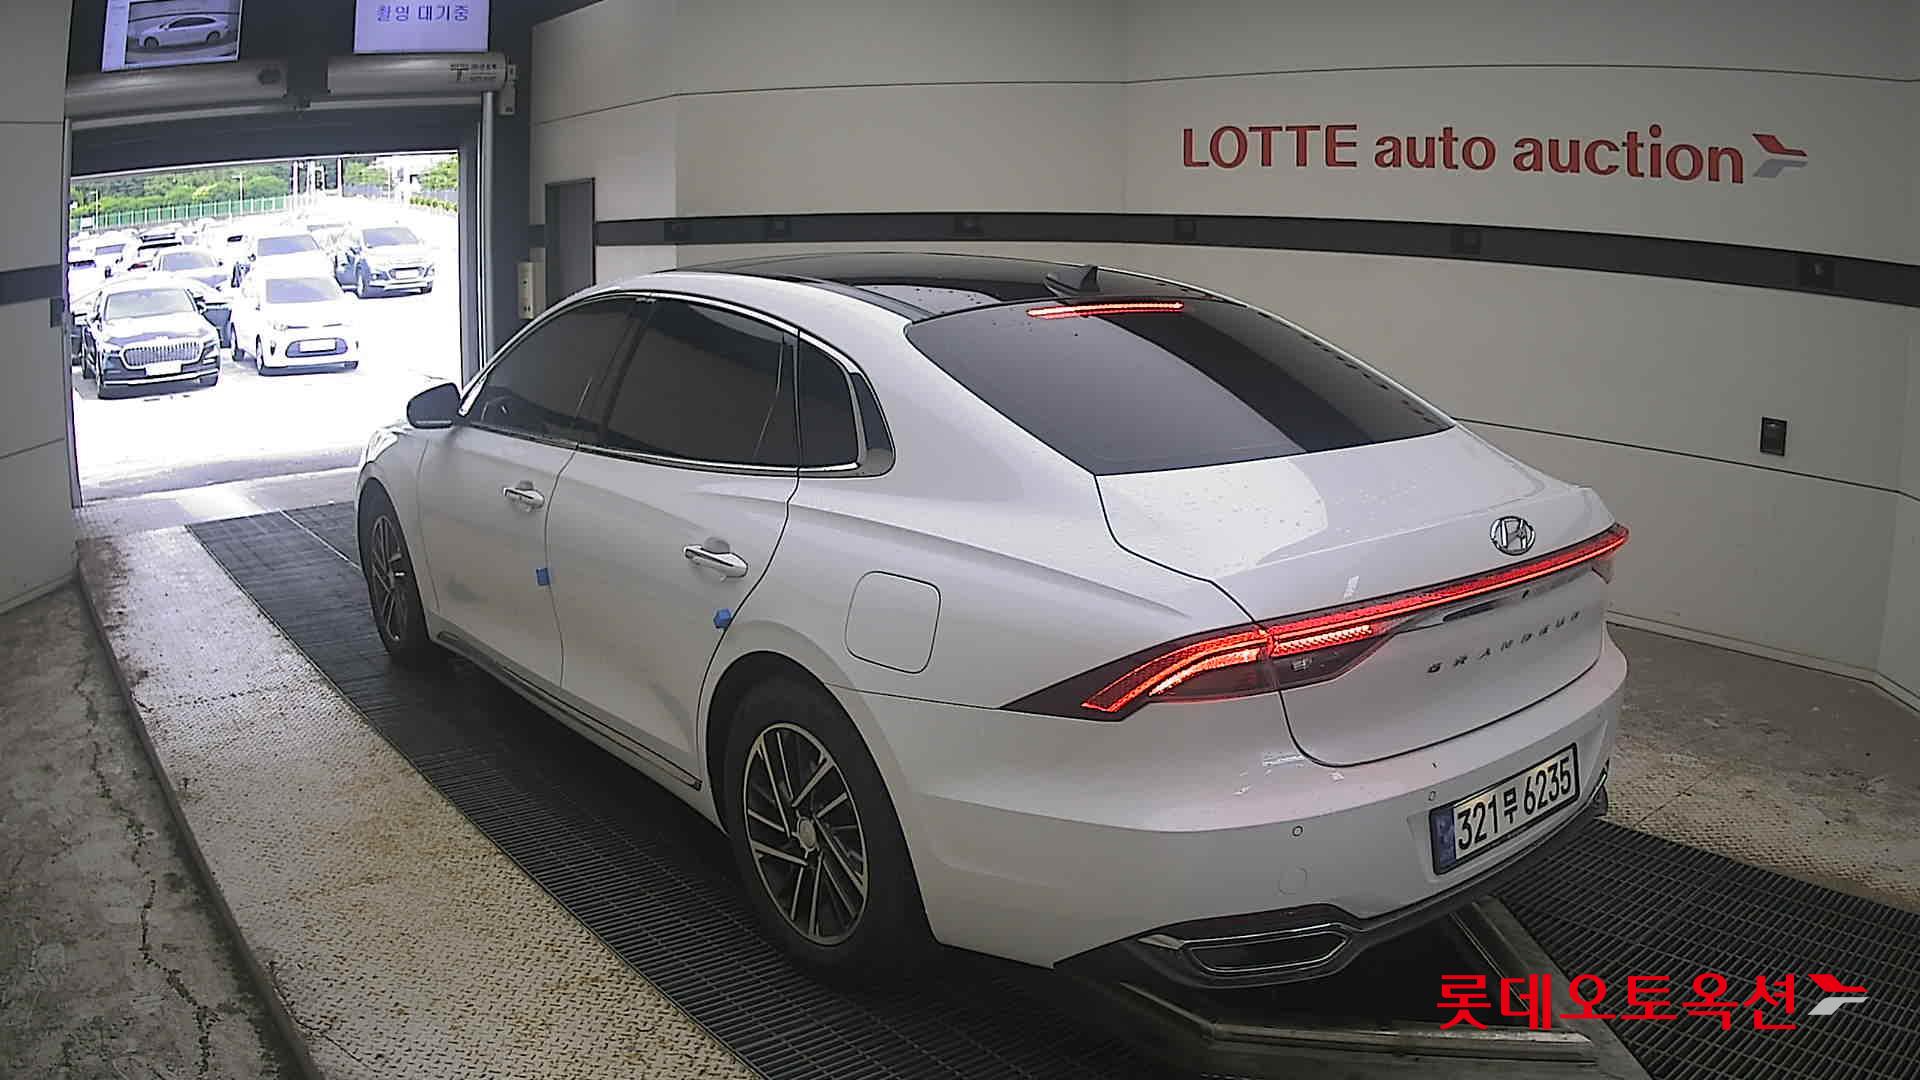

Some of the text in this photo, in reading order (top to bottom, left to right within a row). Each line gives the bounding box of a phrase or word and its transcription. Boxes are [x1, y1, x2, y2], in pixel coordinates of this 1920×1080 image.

[418, 5, 468, 21] 대기중
[1183, 124, 1744, 184] LOTTE auto auction
[1427, 611, 1580, 674] GRANDEUR
